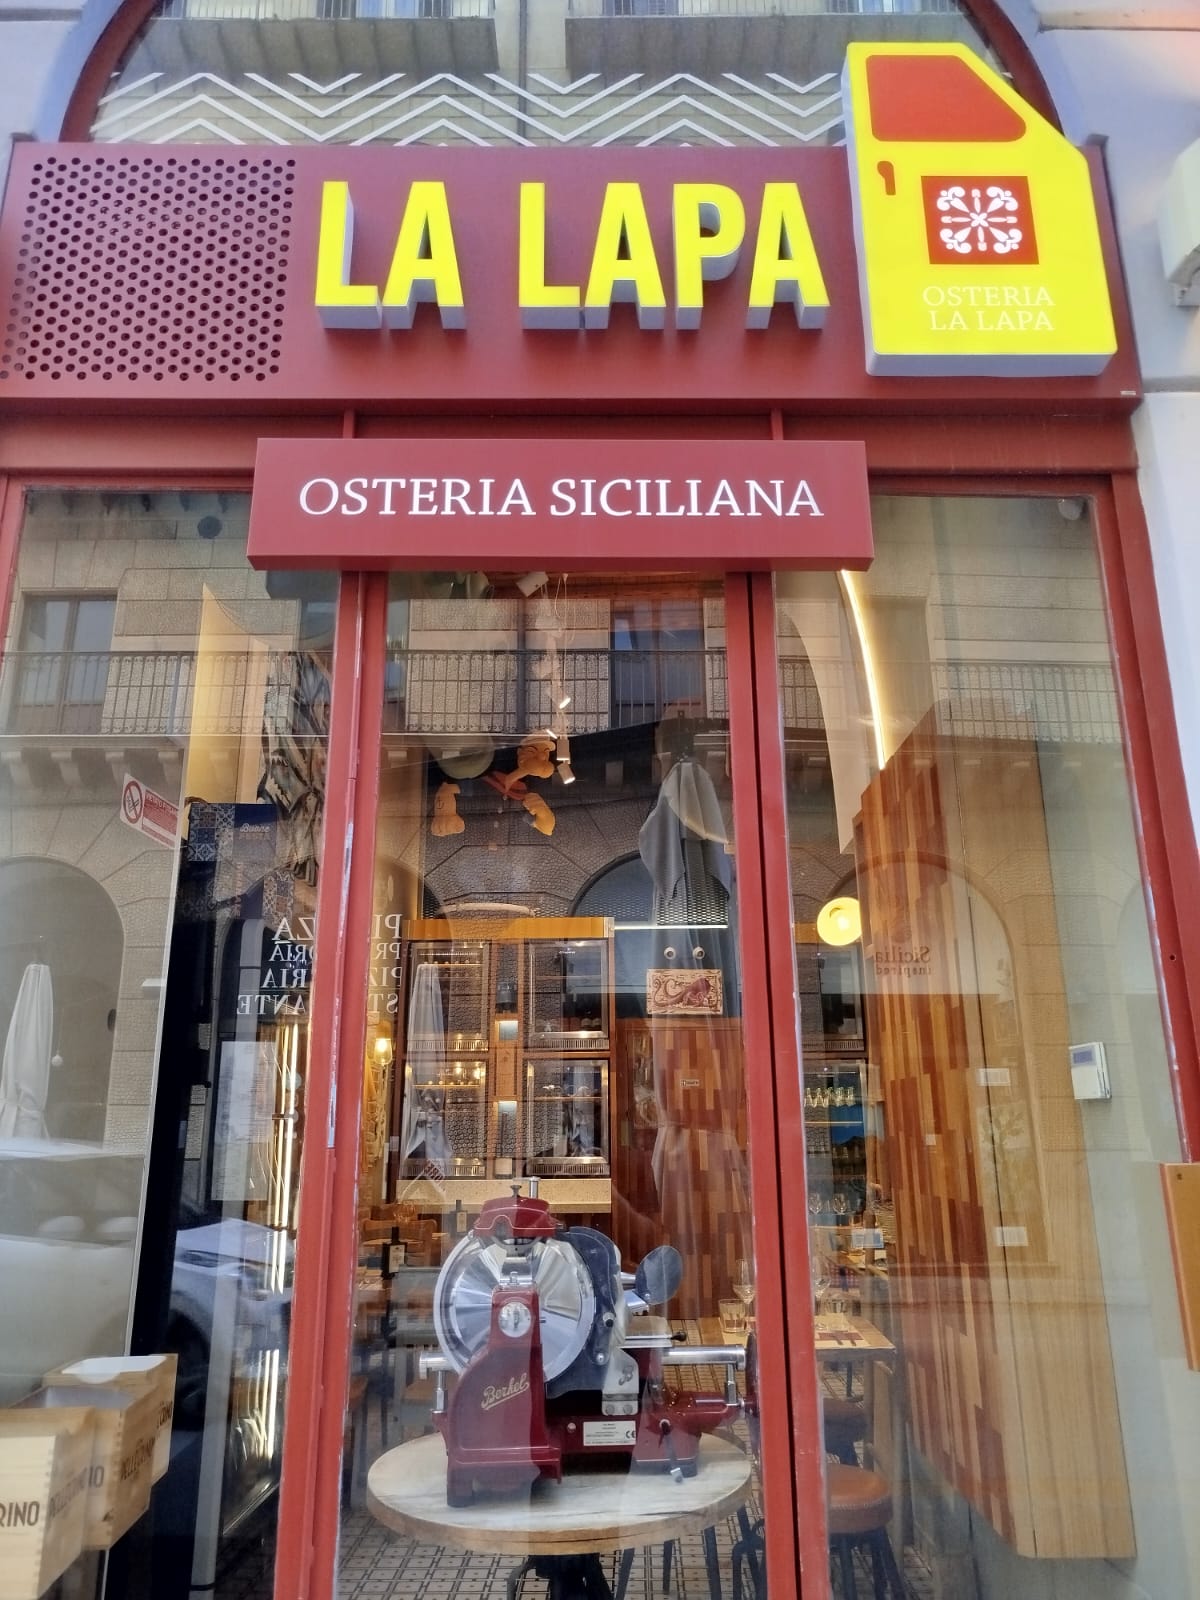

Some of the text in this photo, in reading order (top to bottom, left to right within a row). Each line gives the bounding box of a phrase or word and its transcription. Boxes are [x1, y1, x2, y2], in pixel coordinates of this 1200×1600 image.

[315, 181, 831, 308] LA LAPA
[922, 286, 1057, 307] OSTERIA
[928, 310, 1056, 331] LA LAPA
[299, 477, 825, 517] OSTERIA SICILIANA
[481, 1372, 530, 1411] Berkel
